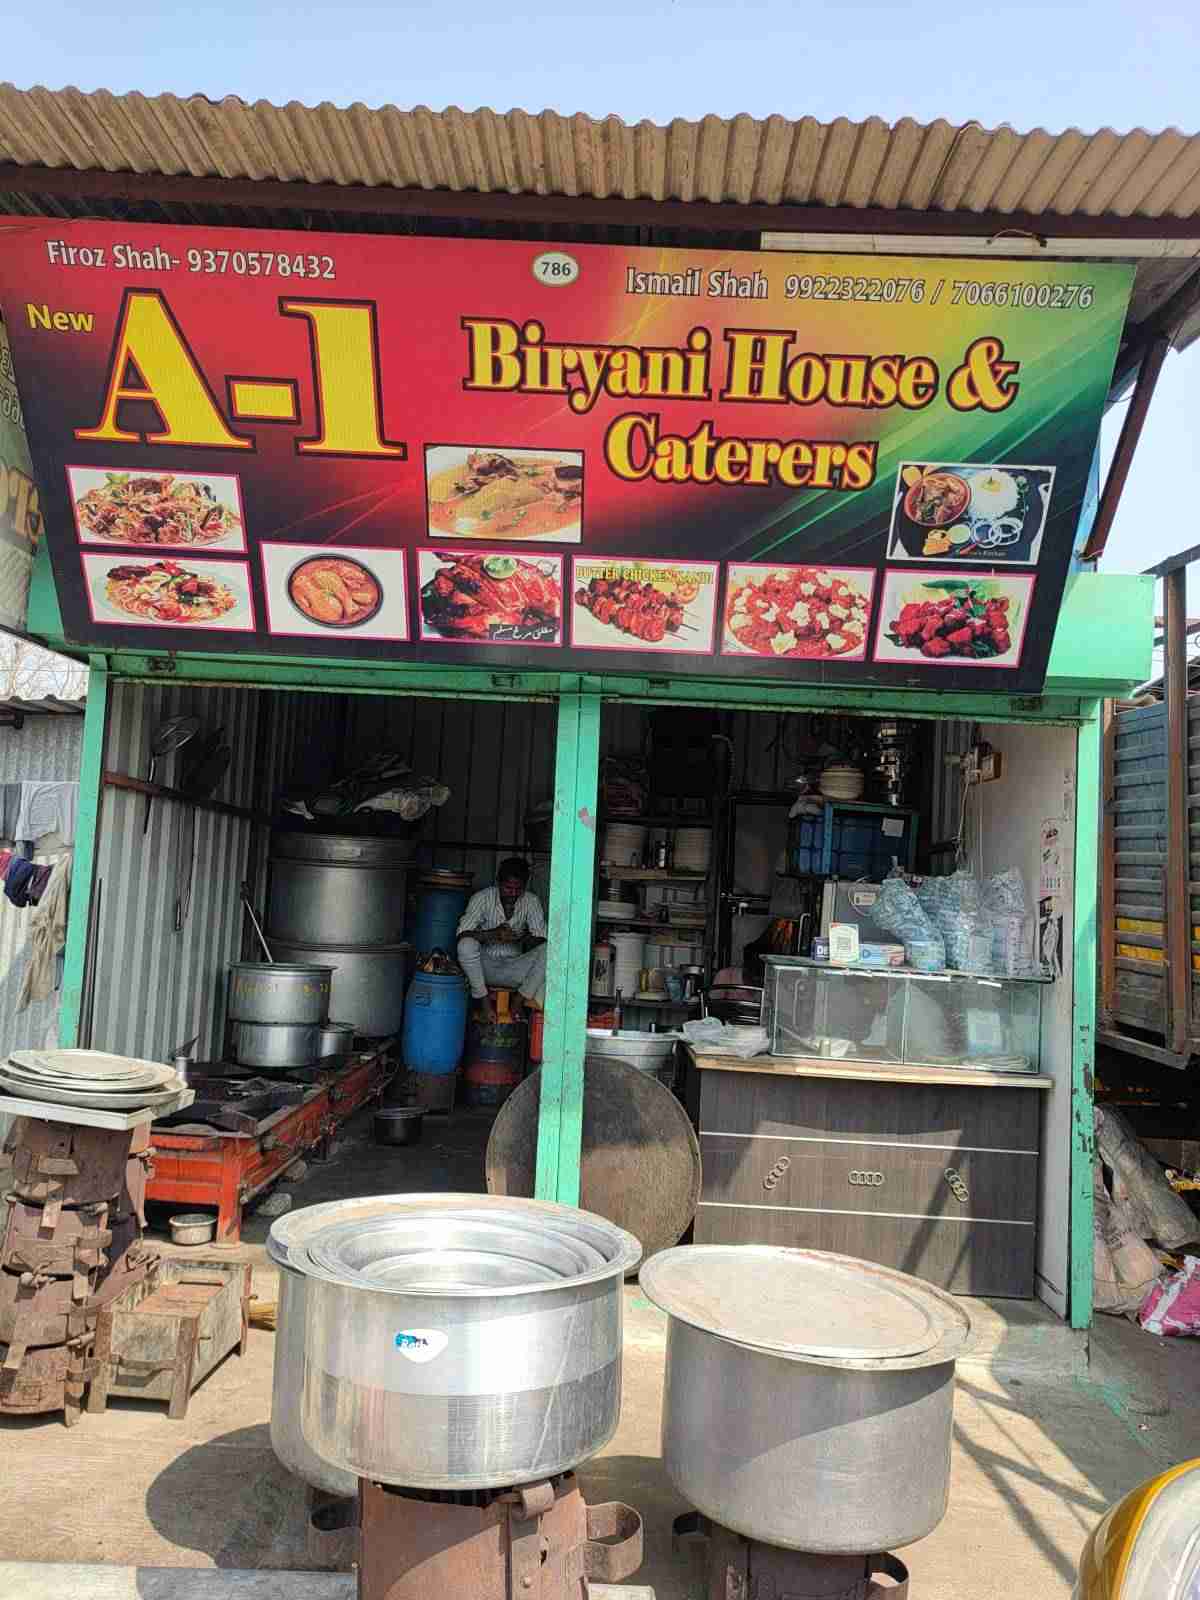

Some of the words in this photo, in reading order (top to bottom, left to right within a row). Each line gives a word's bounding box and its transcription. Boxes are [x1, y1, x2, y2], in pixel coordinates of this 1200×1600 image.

[47, 240, 106, 268] Firoz
[112, 245, 181, 271] Shah-
[187, 249, 336, 279] 9370578432
[541, 261, 571, 277] 786
[626, 266, 702, 297] Ismail
[708, 268, 769, 299] Shah
[784, 274, 926, 303] 9922322076
[930, 279, 945, 304] /
[951, 279, 1095, 309] 7066100276
[25, 303, 95, 332] New
[73, 288, 408, 460] A-1
[461, 316, 713, 414] Biryani
[719, 327, 939, 410] House
[946, 336, 1020, 412] &
[603, 411, 879, 492] Caterers
